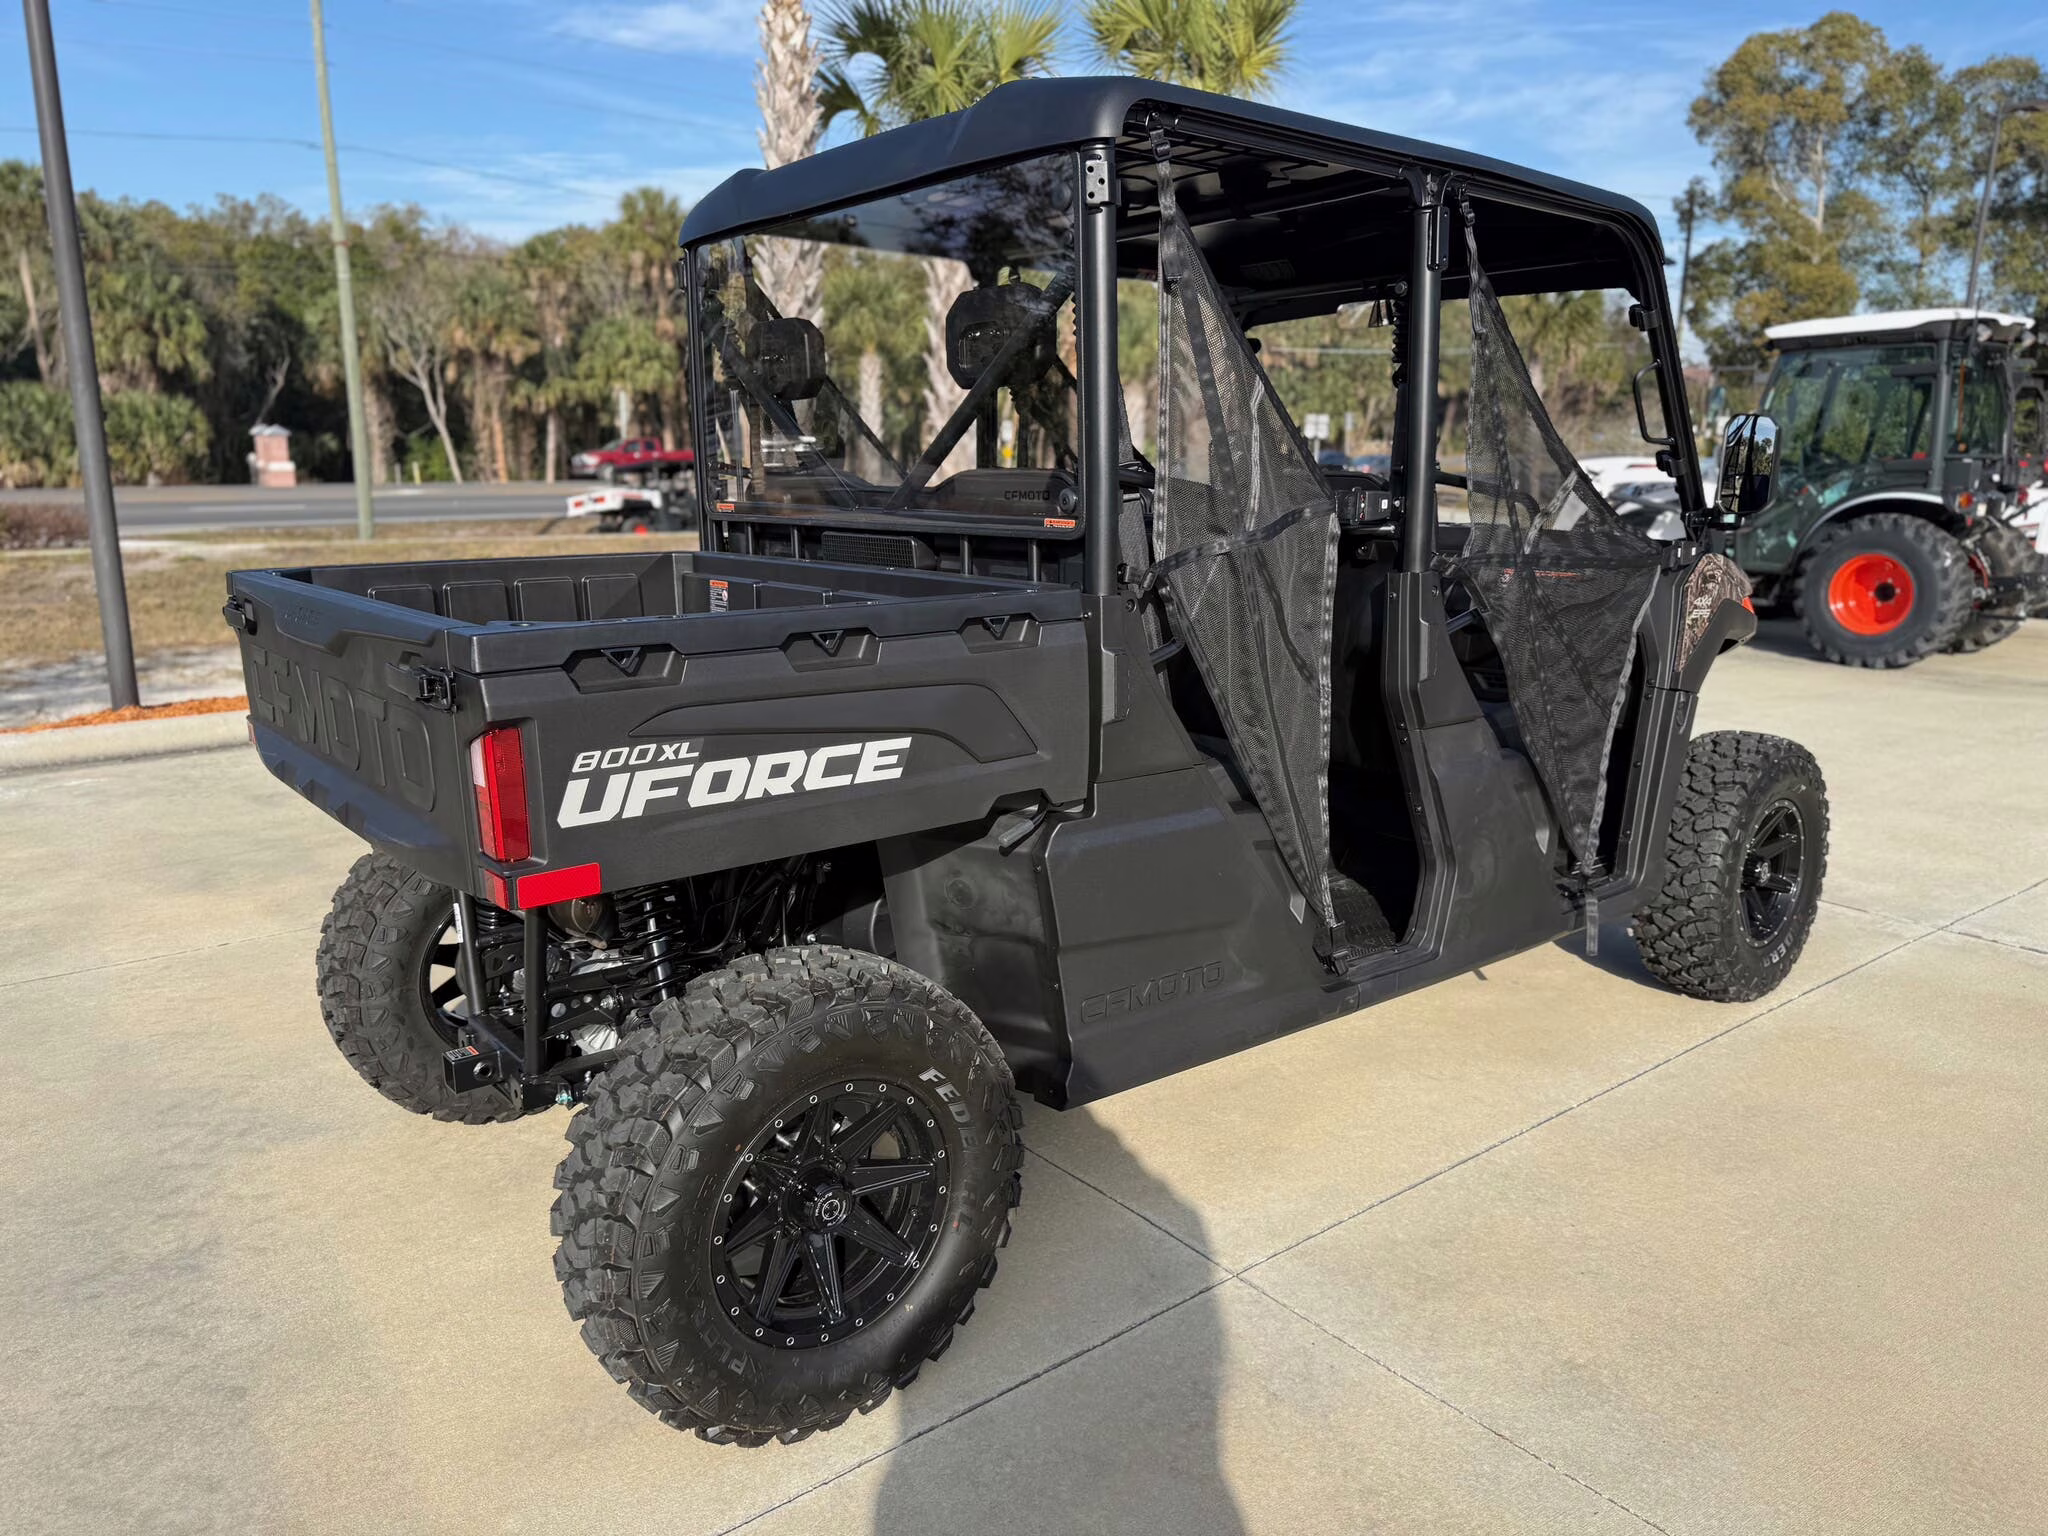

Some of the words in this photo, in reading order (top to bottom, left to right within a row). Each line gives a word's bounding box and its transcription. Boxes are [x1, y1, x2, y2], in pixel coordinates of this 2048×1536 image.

[1004, 490, 1050, 500] CFMOTO
[250, 647, 436, 812] CFMOTO
[557, 737, 912, 828] UFORCE
[1080, 960, 1225, 1024] CFMOTO
